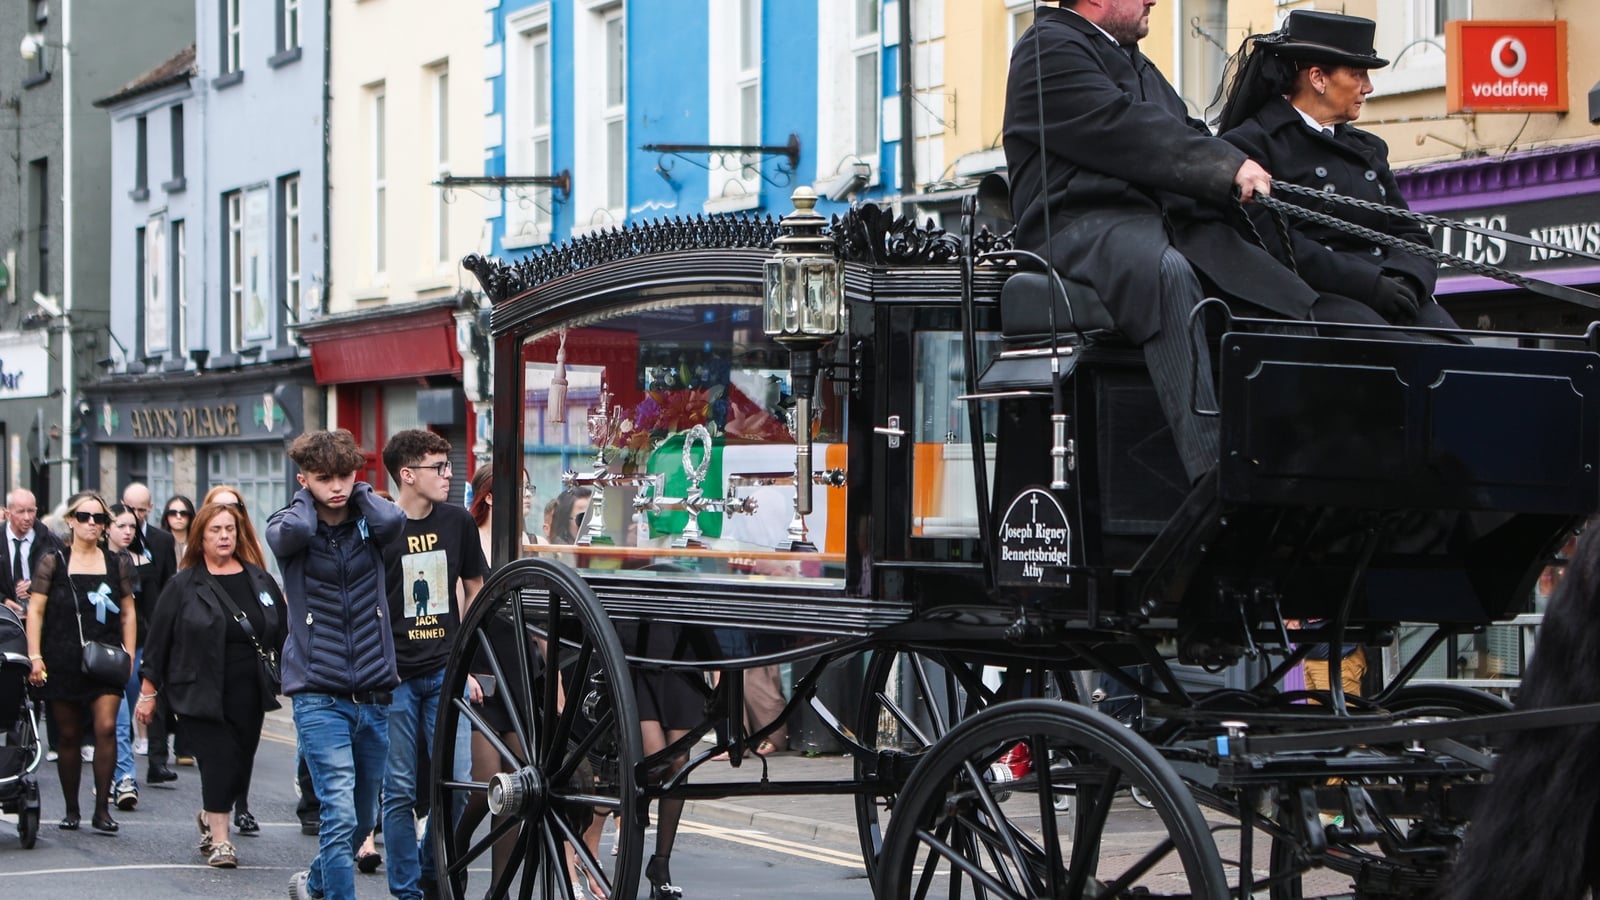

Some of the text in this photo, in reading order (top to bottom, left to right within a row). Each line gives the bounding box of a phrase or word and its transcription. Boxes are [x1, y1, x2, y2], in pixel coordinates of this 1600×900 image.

[1471, 79, 1549, 97] vodafone
[1421, 215, 1508, 268] LES
[182, 403, 240, 437] PLACE
[407, 533, 438, 553] RIP
[1002, 523, 1067, 544] Joseph Rigney
[1001, 545, 1067, 567] Bennettsbridge
[1022, 562, 1045, 583] Athy
[415, 615, 439, 626] JACK
